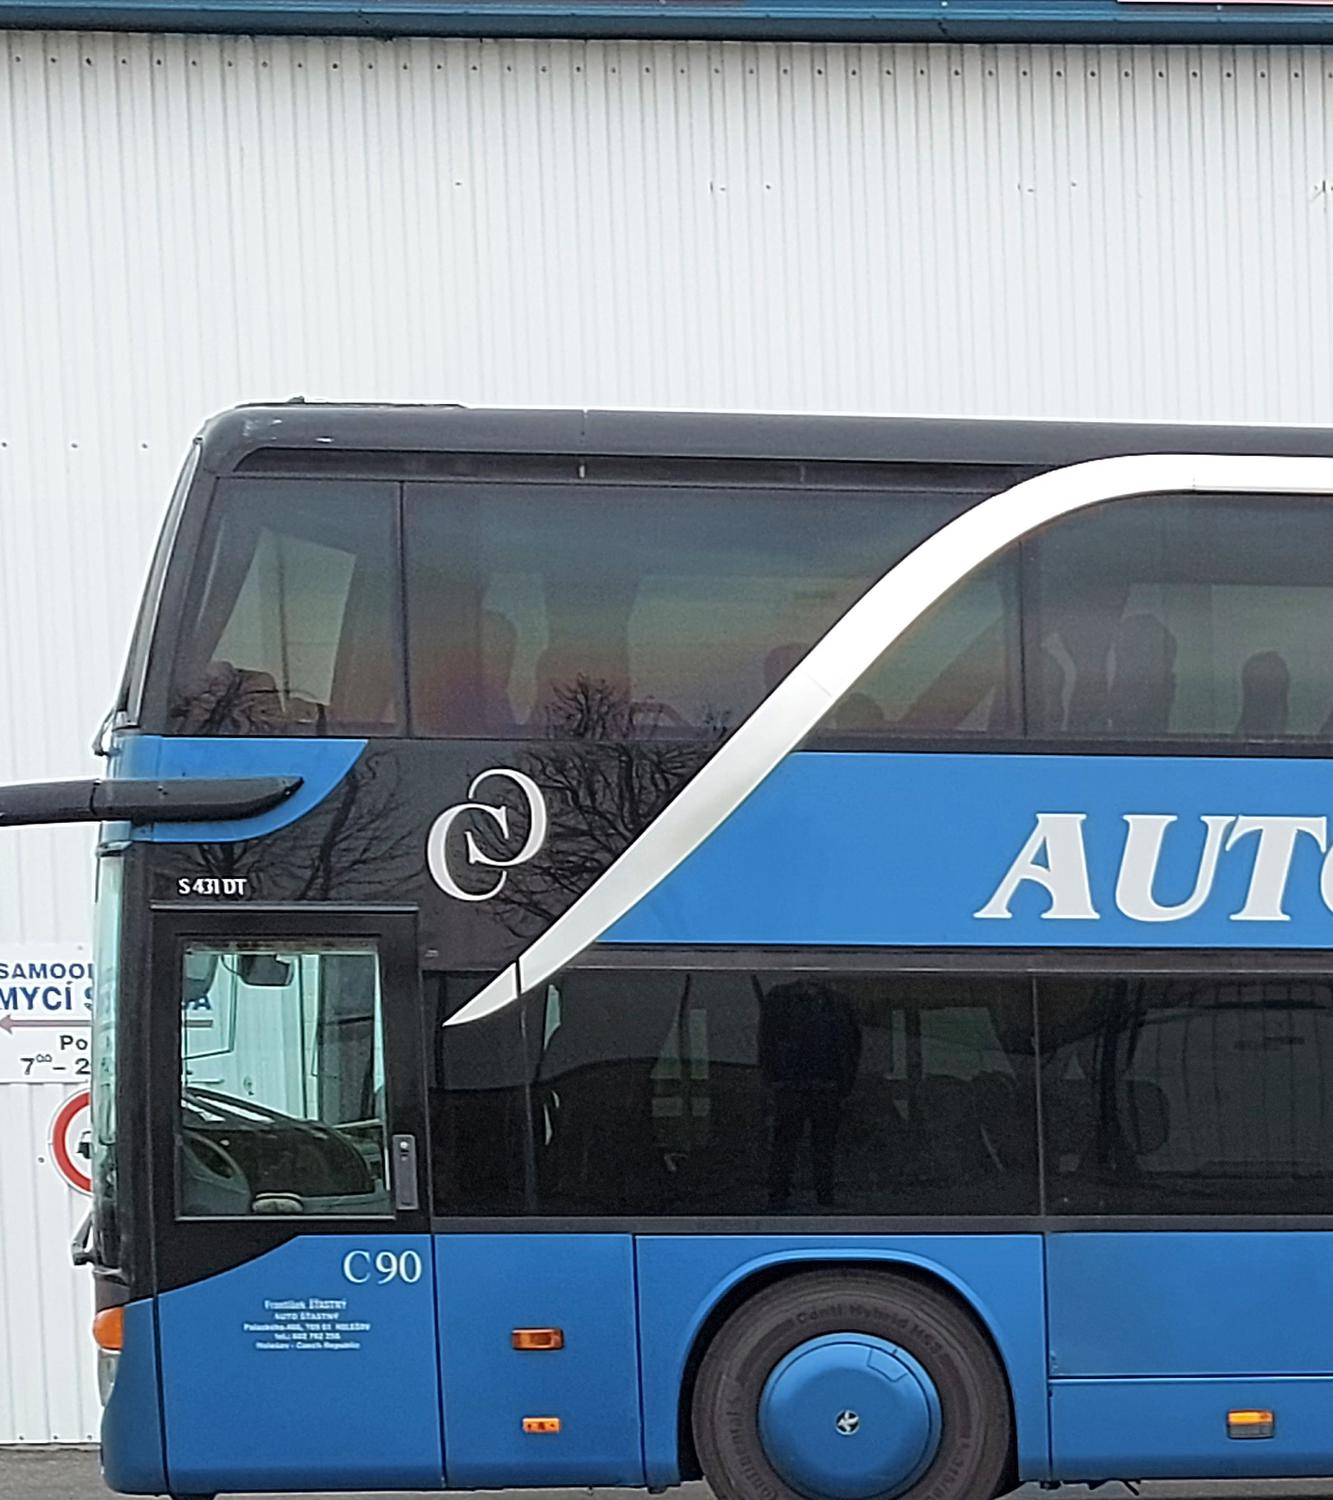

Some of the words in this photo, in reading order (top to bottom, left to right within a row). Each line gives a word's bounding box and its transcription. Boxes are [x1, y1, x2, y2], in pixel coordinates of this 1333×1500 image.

[178, 878, 191, 895] S
[192, 878, 220, 895] 431
[221, 878, 248, 896] DT
[0, 962, 93, 980] SAMOO
